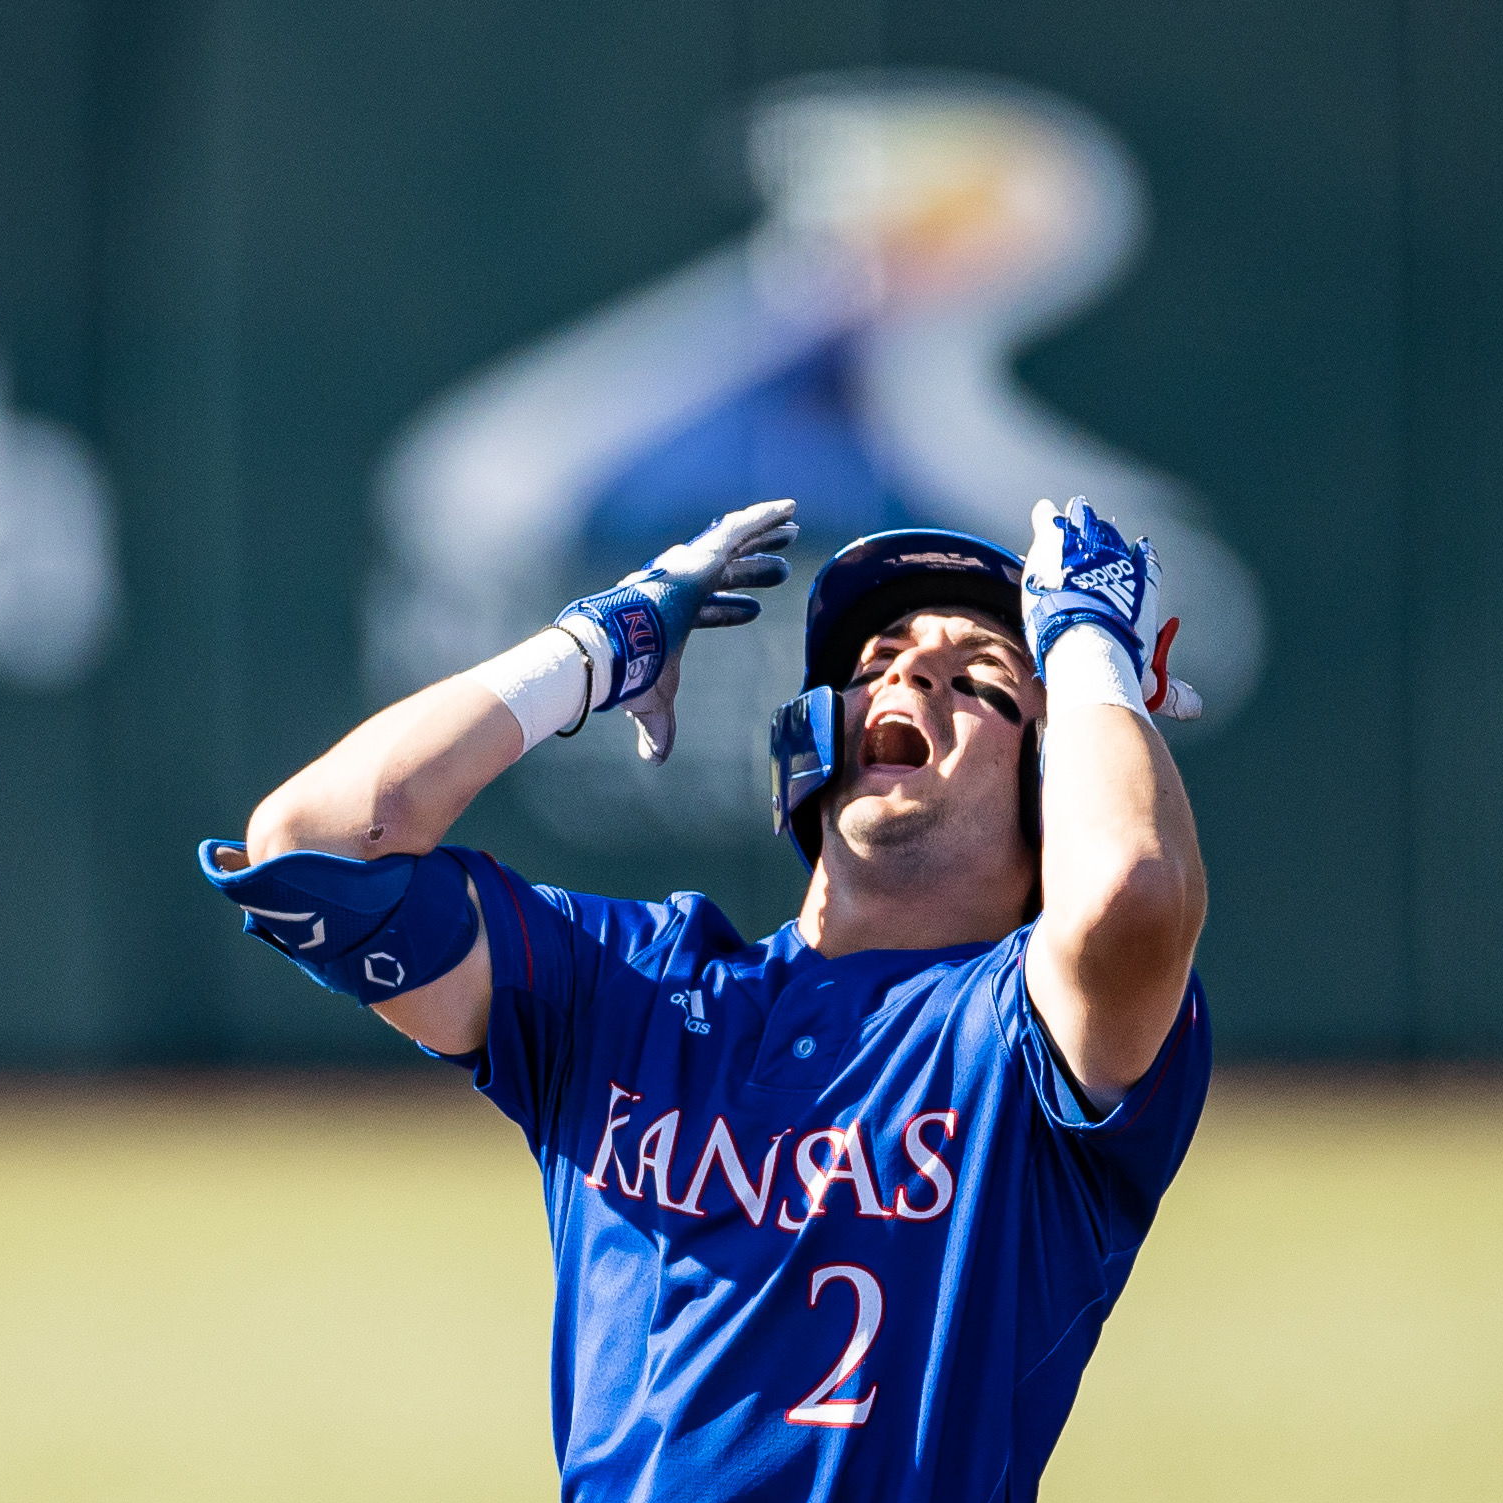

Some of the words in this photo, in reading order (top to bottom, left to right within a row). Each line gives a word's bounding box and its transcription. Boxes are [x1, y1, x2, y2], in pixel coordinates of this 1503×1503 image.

[1070, 559, 1135, 590] adidas
[622, 608, 656, 656] KU
[669, 988, 712, 1035] aas
[584, 1080, 958, 1234] KANSAS
[784, 1260, 886, 1429] 2
